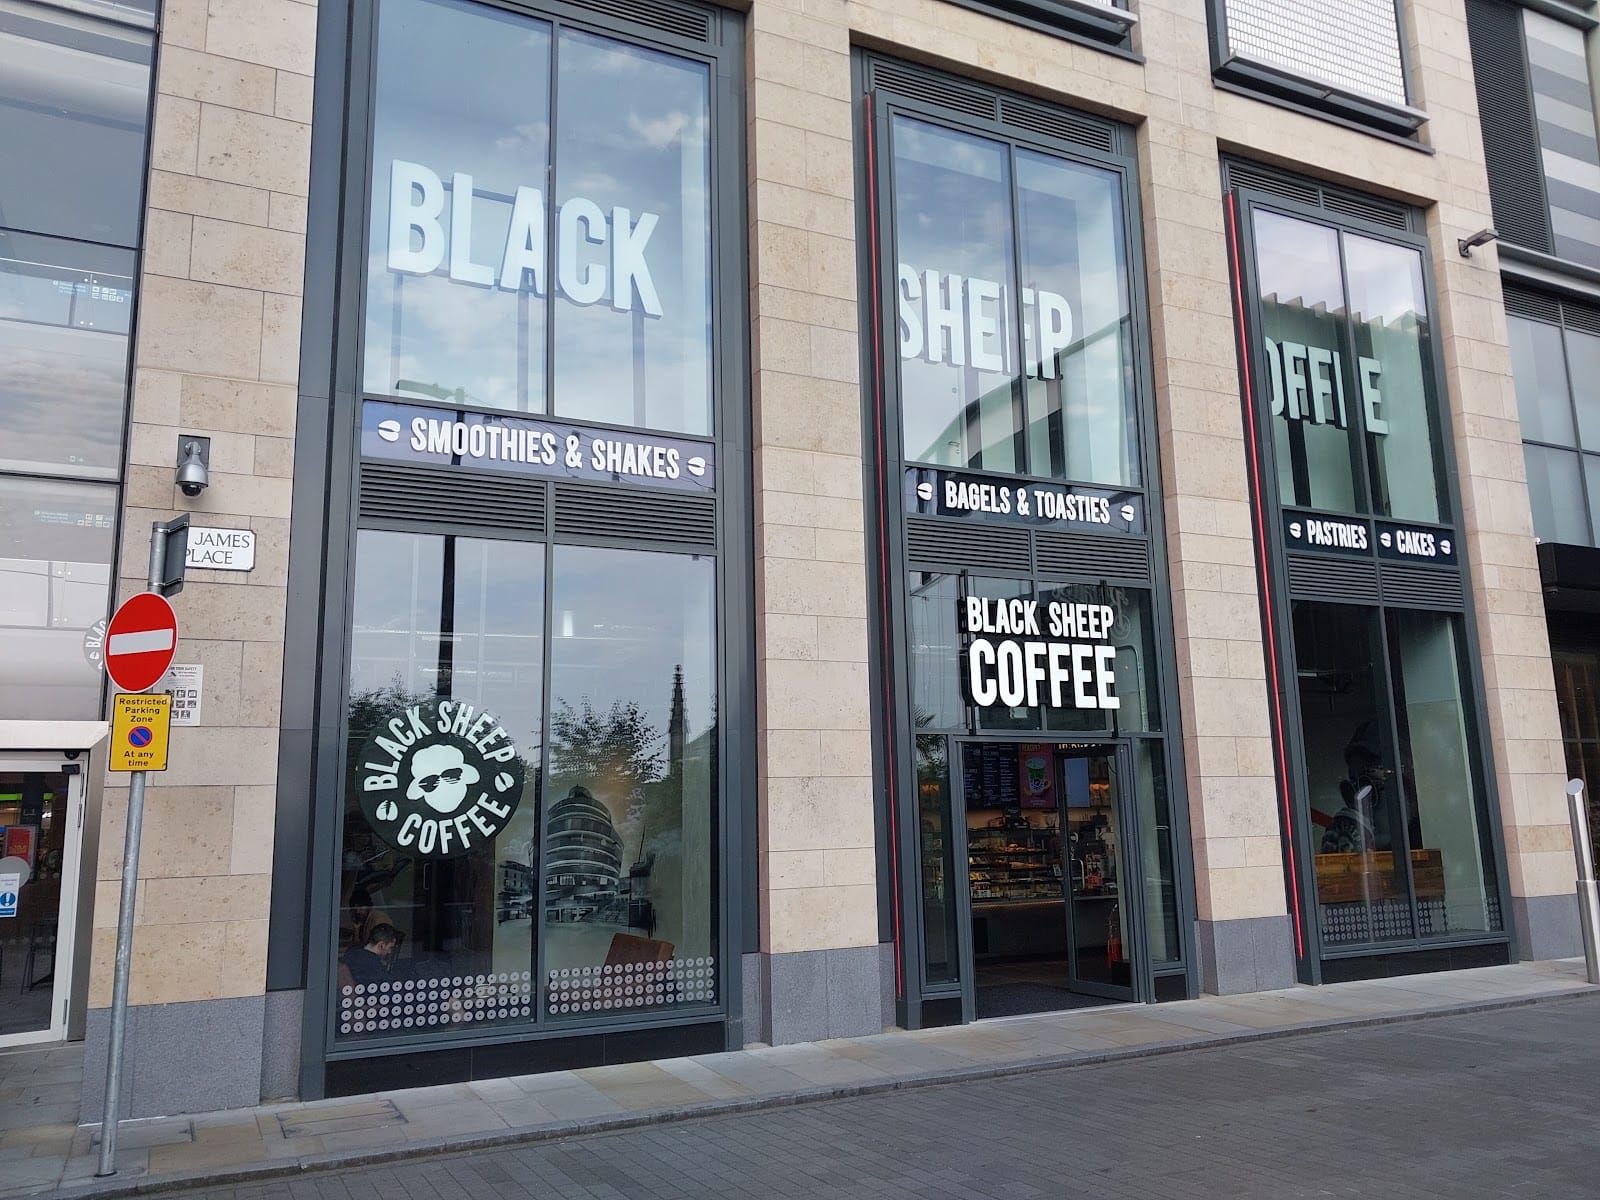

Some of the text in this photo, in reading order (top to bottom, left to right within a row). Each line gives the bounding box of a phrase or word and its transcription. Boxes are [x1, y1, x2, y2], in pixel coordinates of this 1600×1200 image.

[387, 159, 664, 319] BLACK
[410, 417, 680, 479] SMOOTHIES & SHAKES
[945, 479, 1110, 524] BAGELS & TOASTIES
[194, 532, 250, 548] JAMES
[1306, 519, 1436, 557] PASTRIES CAKES
[966, 596, 1114, 639] BLACK SHEEP
[969, 638, 1120, 709] COFFEE
[125, 706, 160, 714] Parking
[124, 750, 154, 759] At any
[363, 701, 516, 792] BLACK SHEEP
[397, 792, 511, 854] COFFEE
